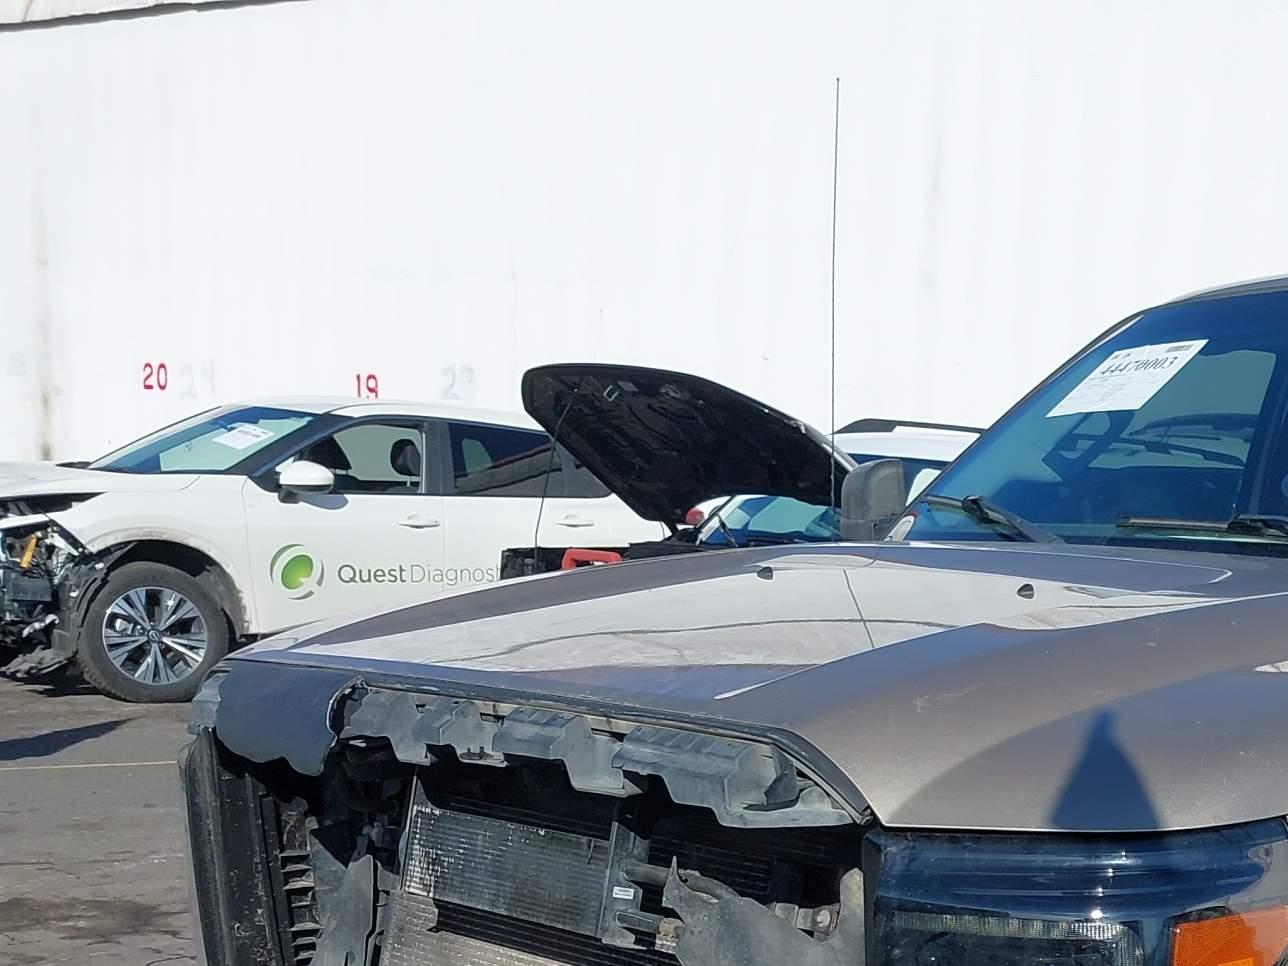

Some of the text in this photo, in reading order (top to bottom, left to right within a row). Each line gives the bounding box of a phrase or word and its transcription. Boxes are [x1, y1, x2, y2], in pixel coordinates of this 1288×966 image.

[143, 362, 168, 390] 20
[356, 373, 379, 398] 19
[337, 564, 406, 584] Quest
